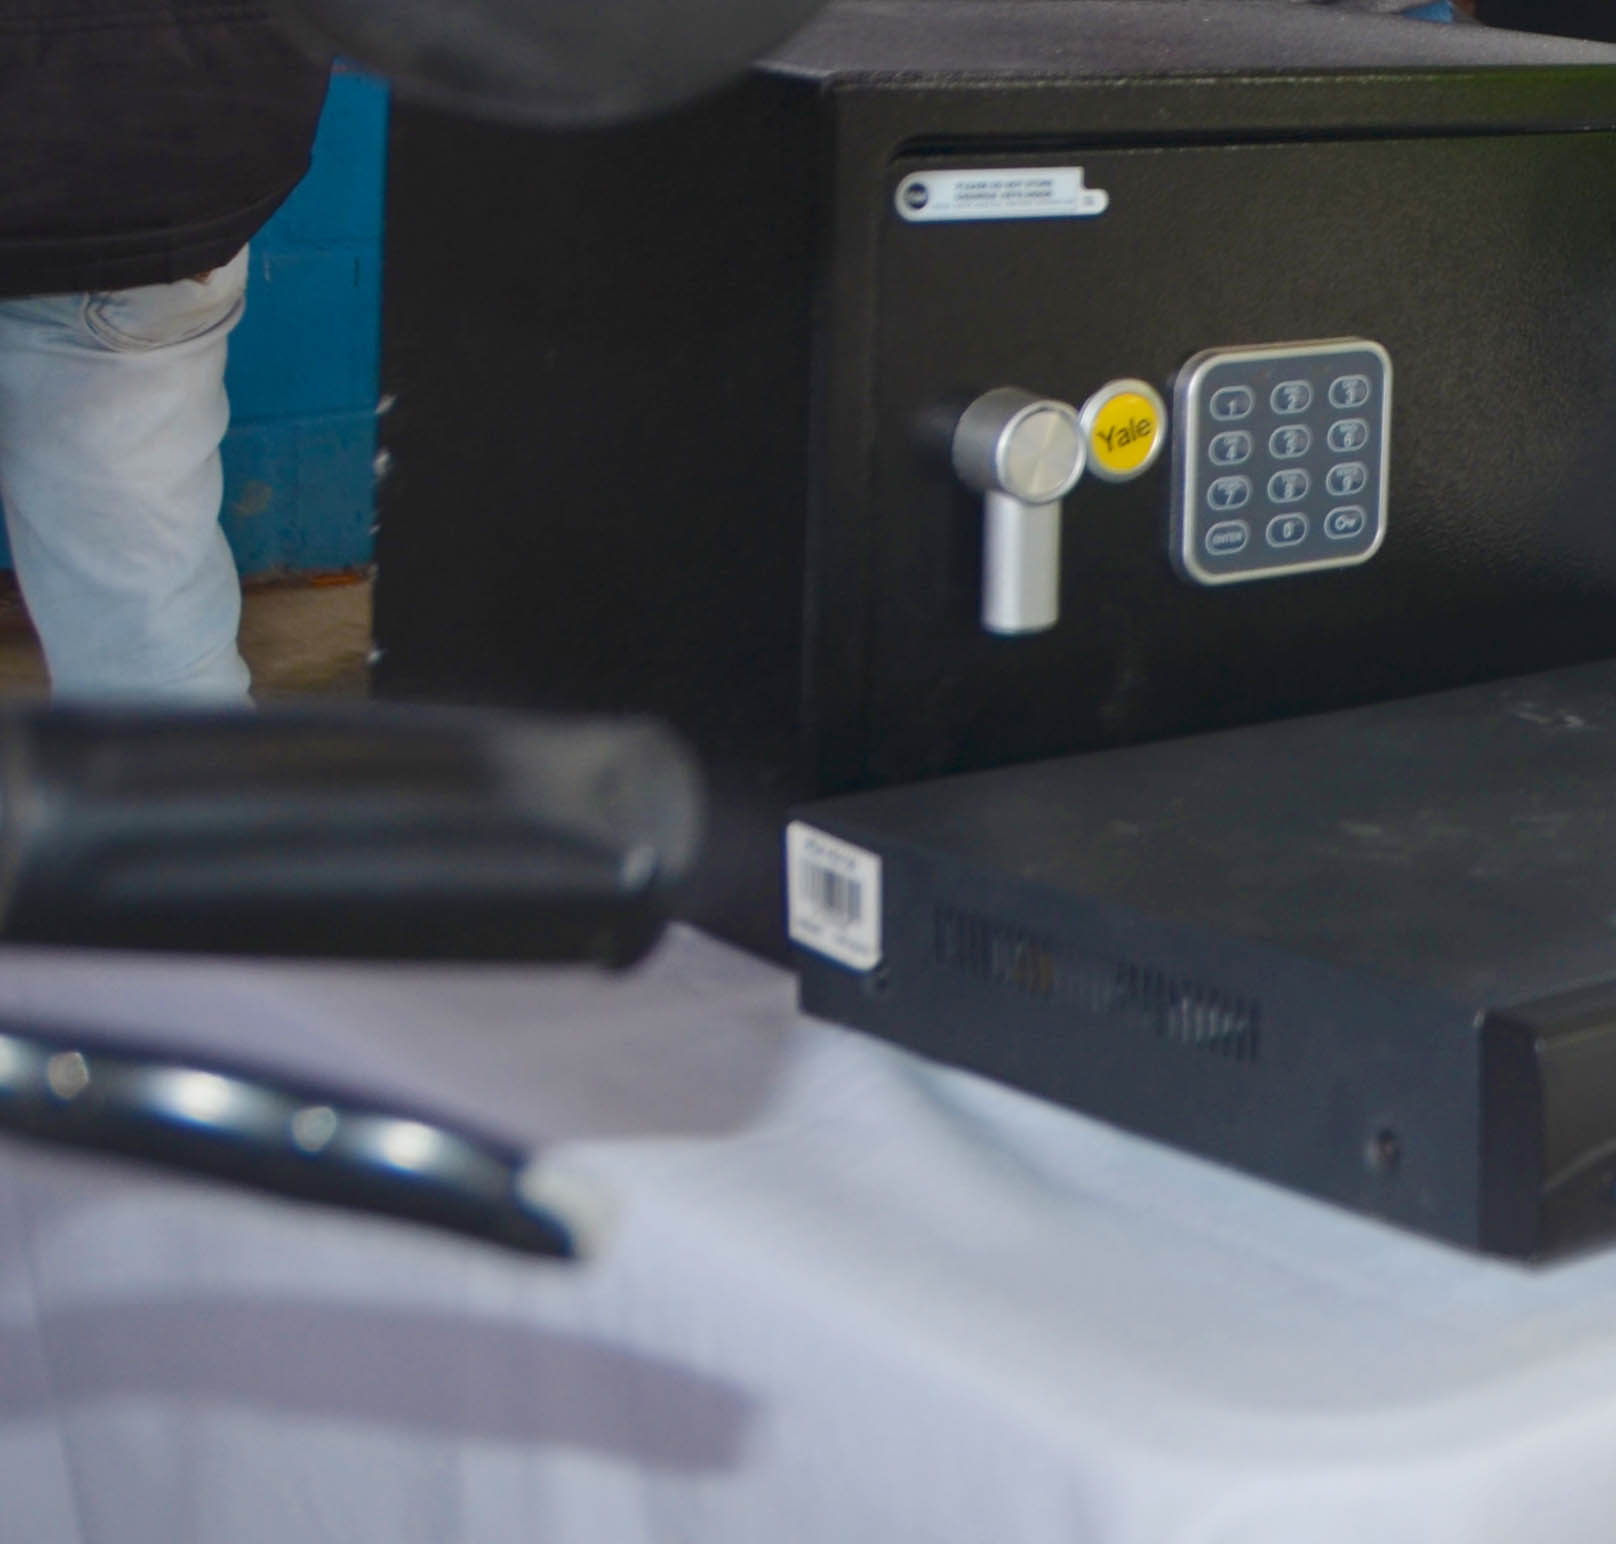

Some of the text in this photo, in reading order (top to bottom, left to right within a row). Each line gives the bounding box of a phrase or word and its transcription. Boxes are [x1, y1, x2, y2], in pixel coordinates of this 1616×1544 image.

[1227, 400, 1237, 415] 1
[1287, 395, 1296, 410] 2
[1097, 417, 1152, 453] Yale
[1226, 446, 1236, 461] 4
[1225, 490, 1235, 506] 7
